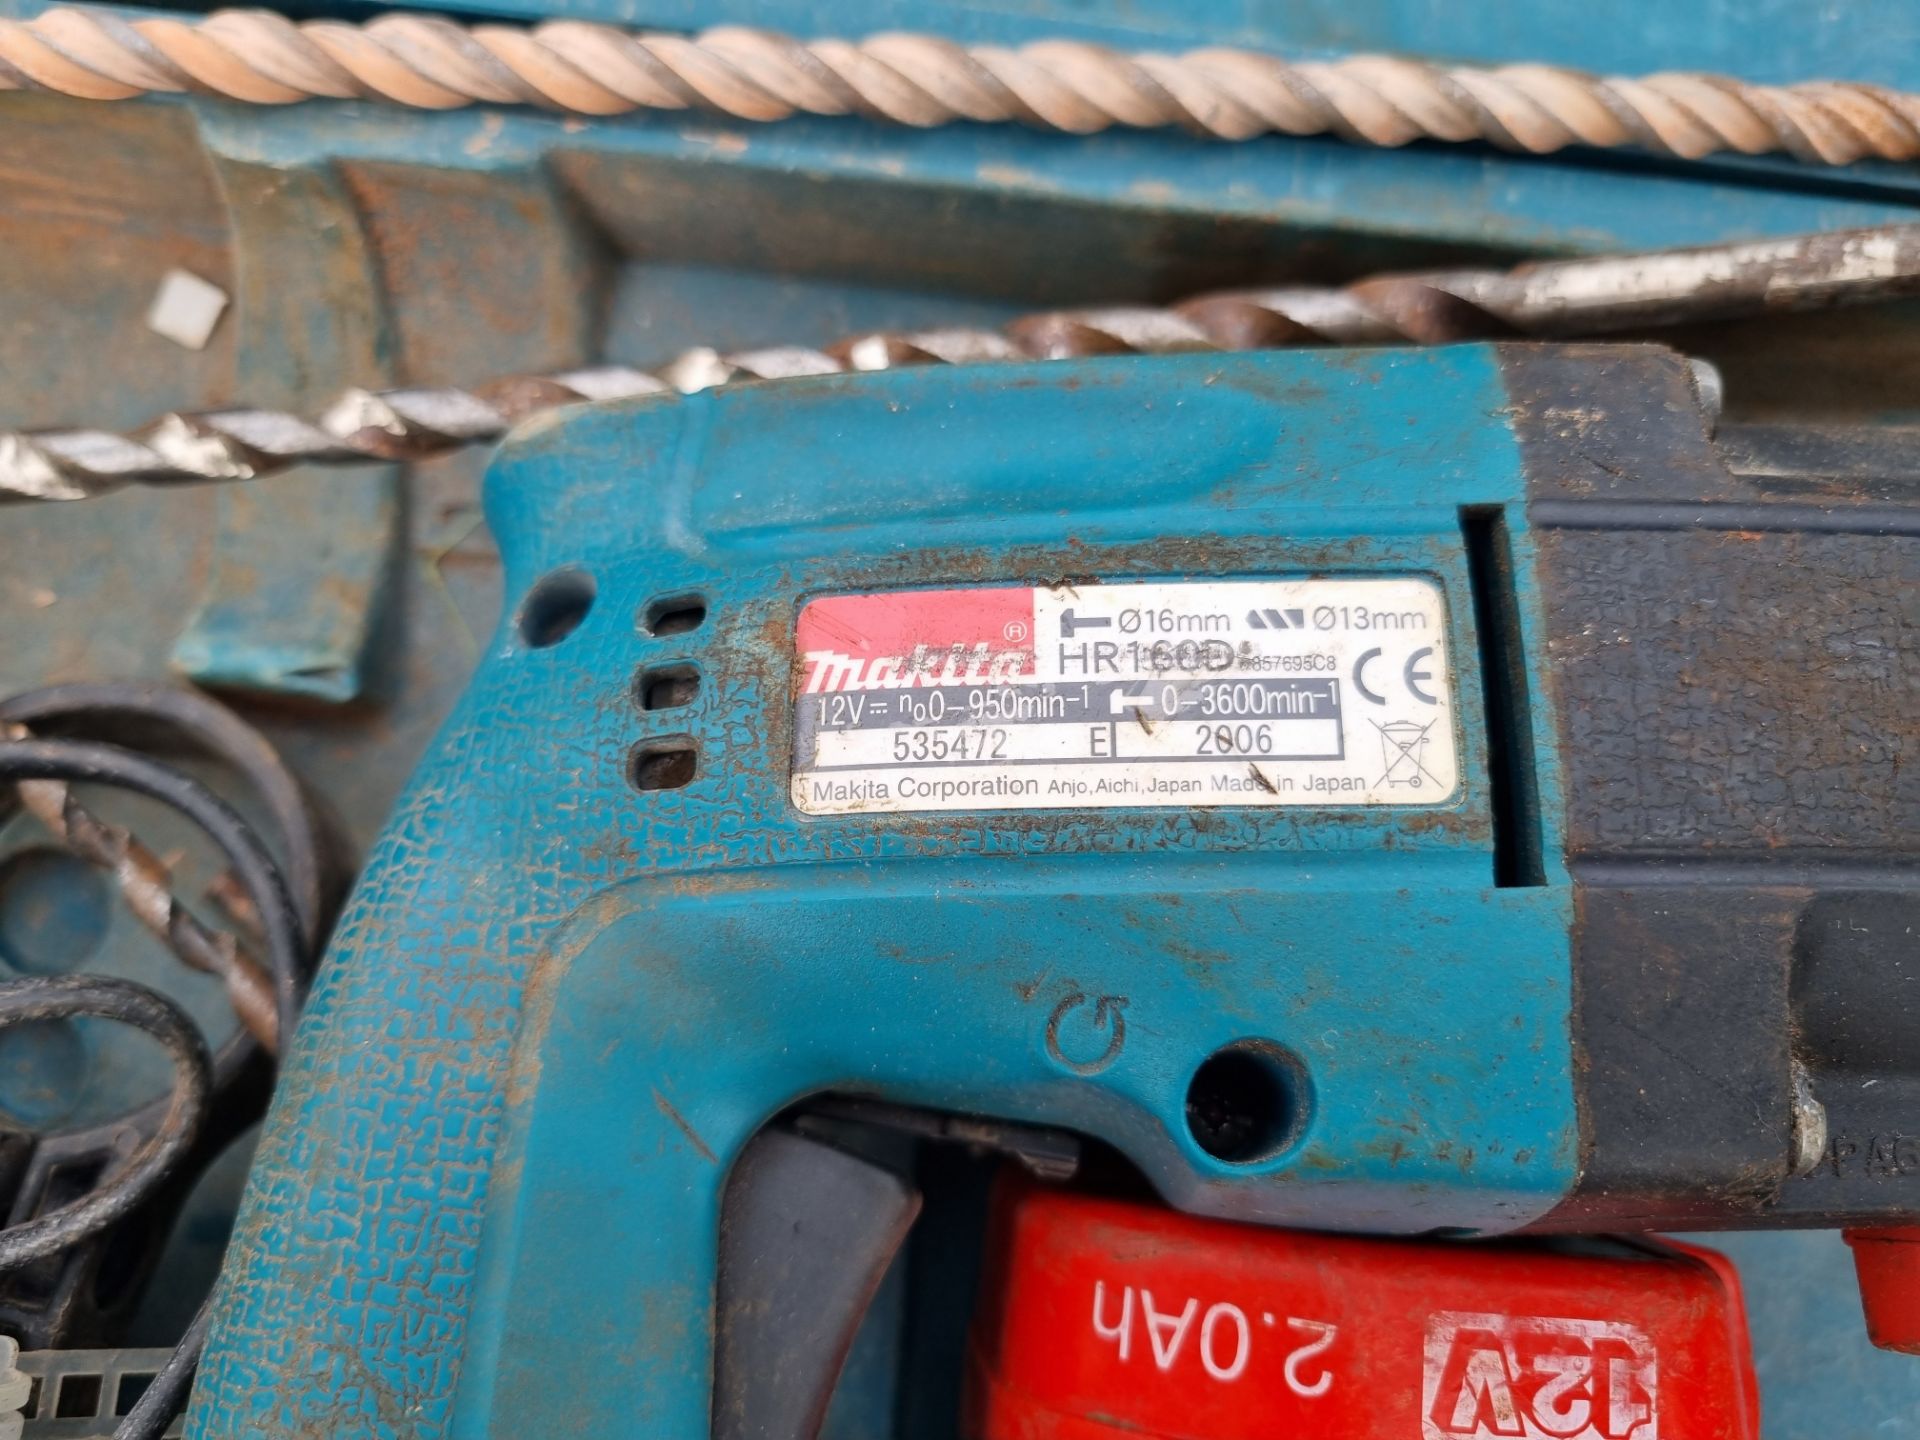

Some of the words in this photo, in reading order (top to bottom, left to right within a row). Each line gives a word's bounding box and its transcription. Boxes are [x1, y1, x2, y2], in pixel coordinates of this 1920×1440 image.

[893, 728, 1008, 761] 535472
[1089, 726, 1107, 757] E
[1195, 725, 1273, 755] 2006
[812, 780, 889, 801] Makita
[897, 775, 1039, 801] Corporation
[1277, 774, 1294, 792] in
[1302, 773, 1366, 796] Japan
[1092, 1281, 1338, 1397] 2.0Ah
